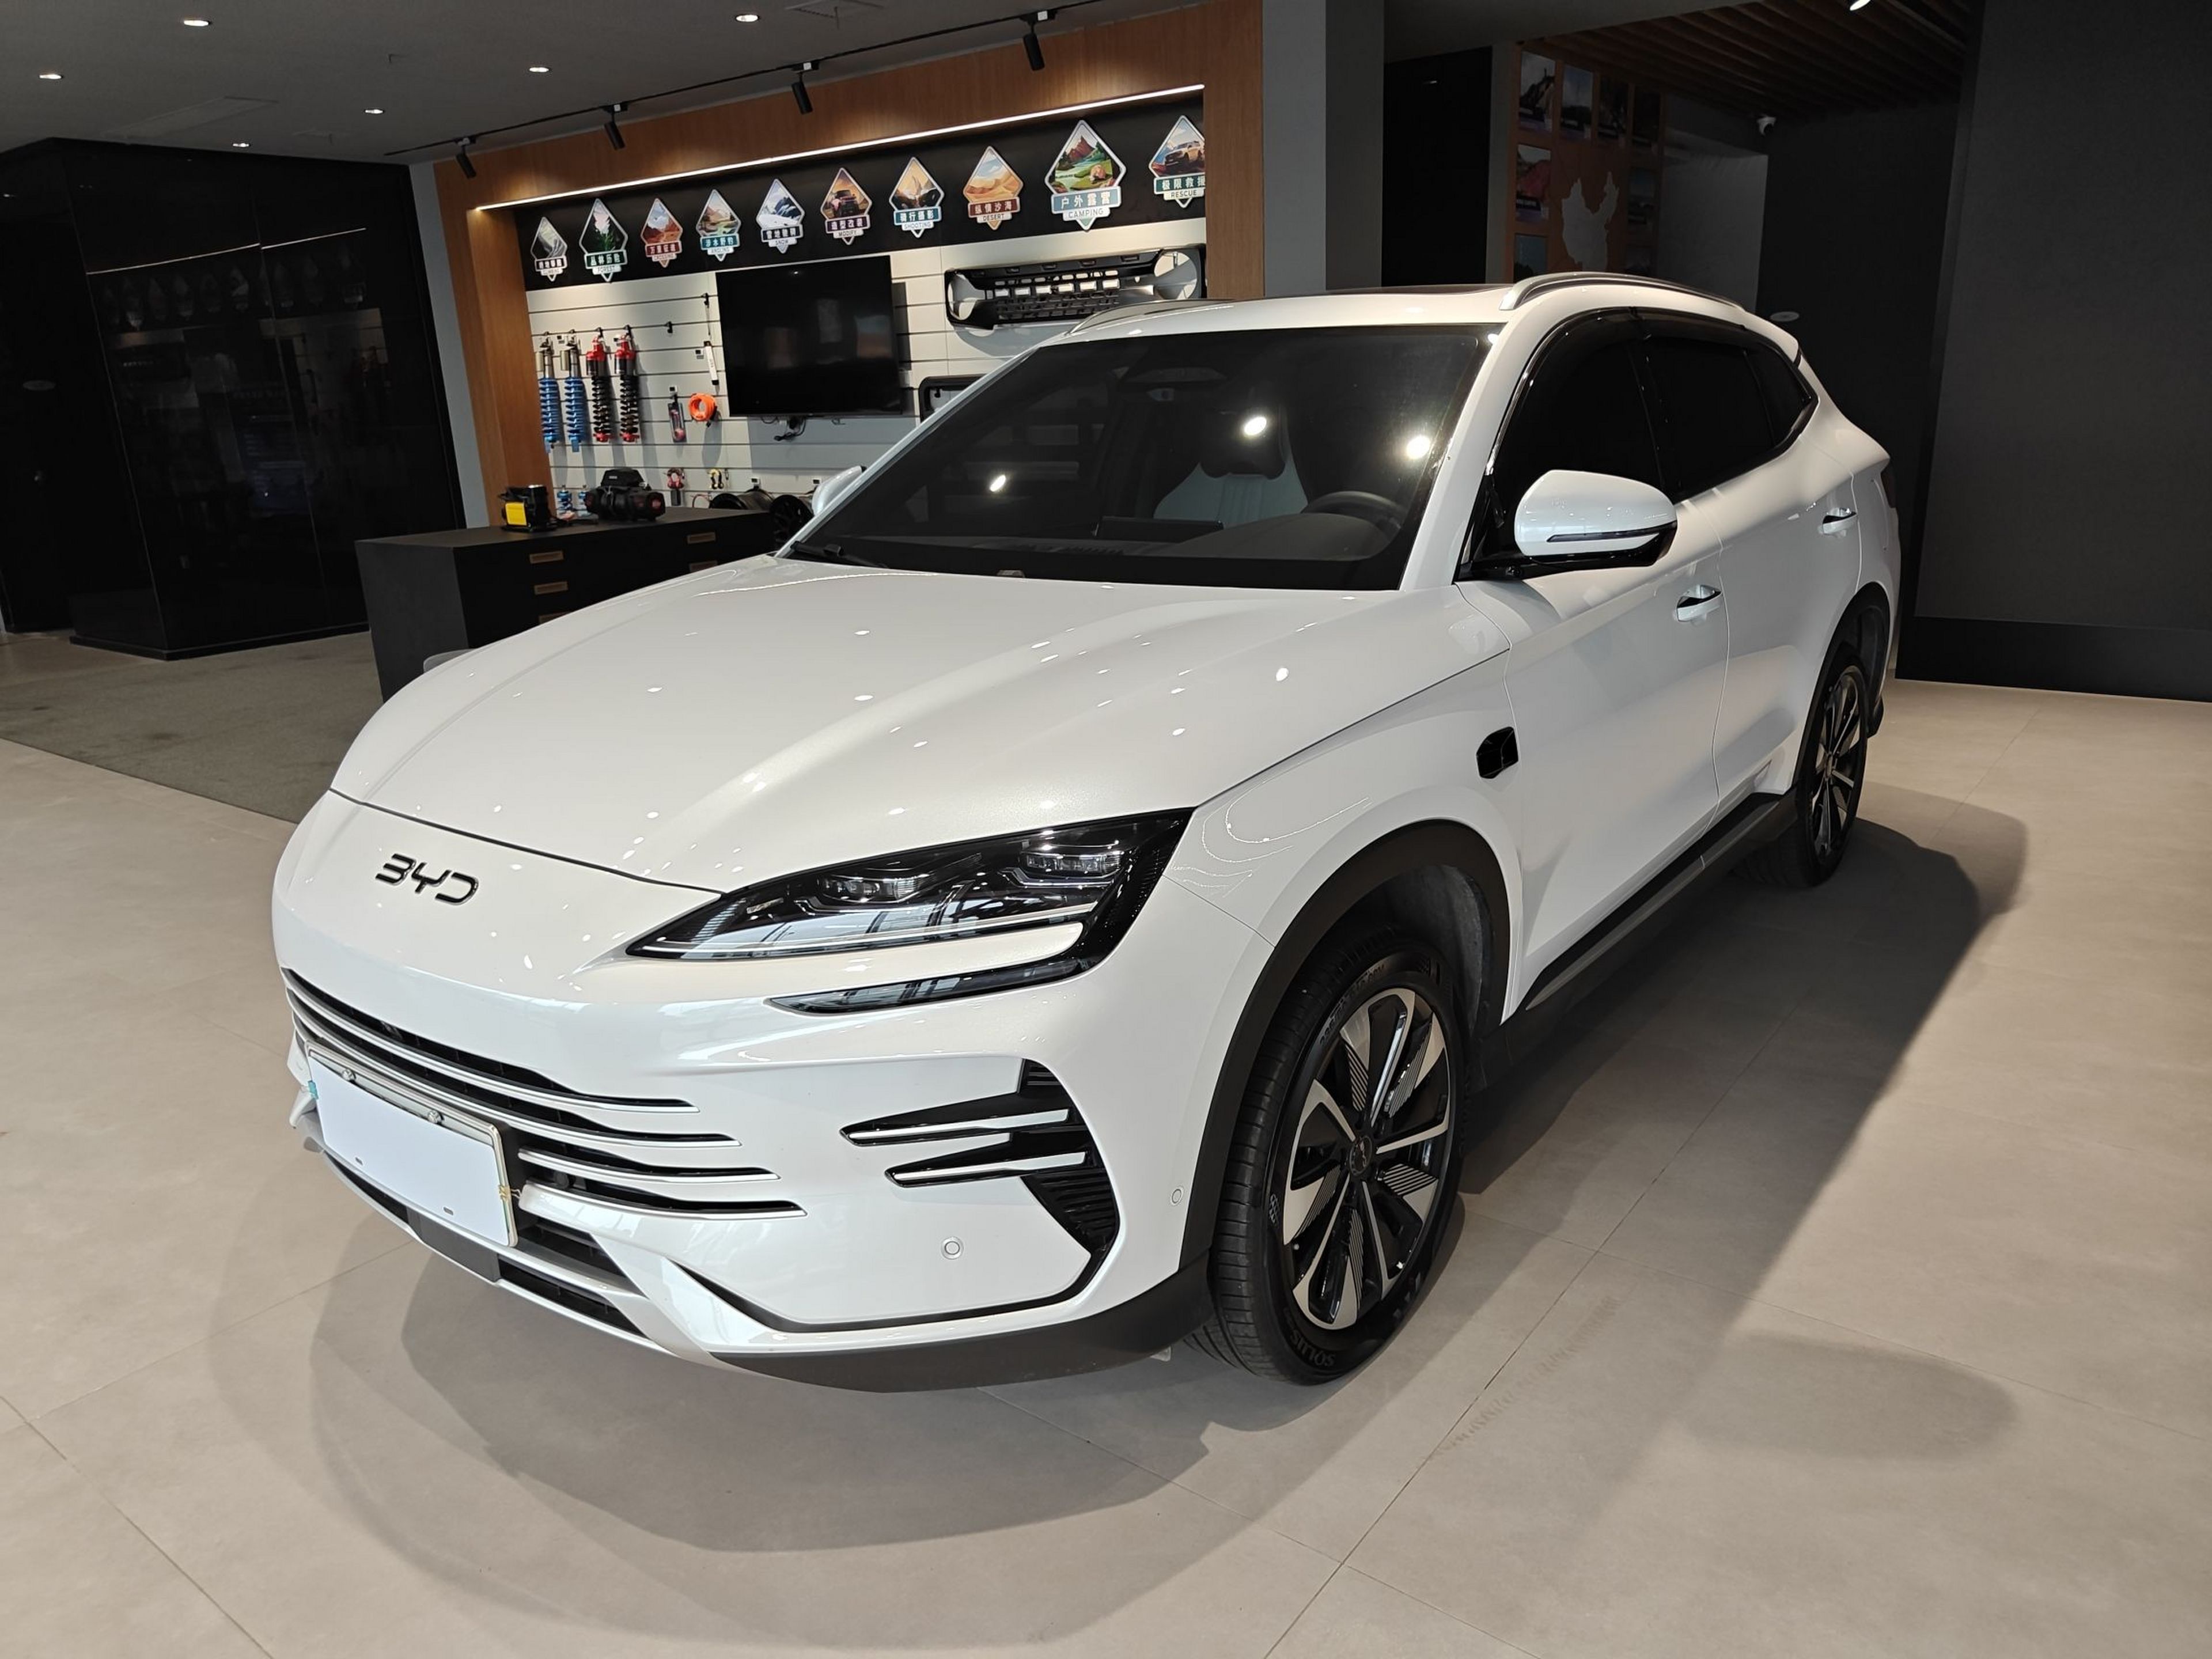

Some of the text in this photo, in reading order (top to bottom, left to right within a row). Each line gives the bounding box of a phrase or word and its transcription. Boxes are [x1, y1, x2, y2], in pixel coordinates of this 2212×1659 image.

[1171, 190, 1198, 198] RESCUE
[1069, 208, 1104, 218] CAMPING
[375, 853, 479, 905] BYD
[1290, 1330, 1335, 1366] SOLUS
